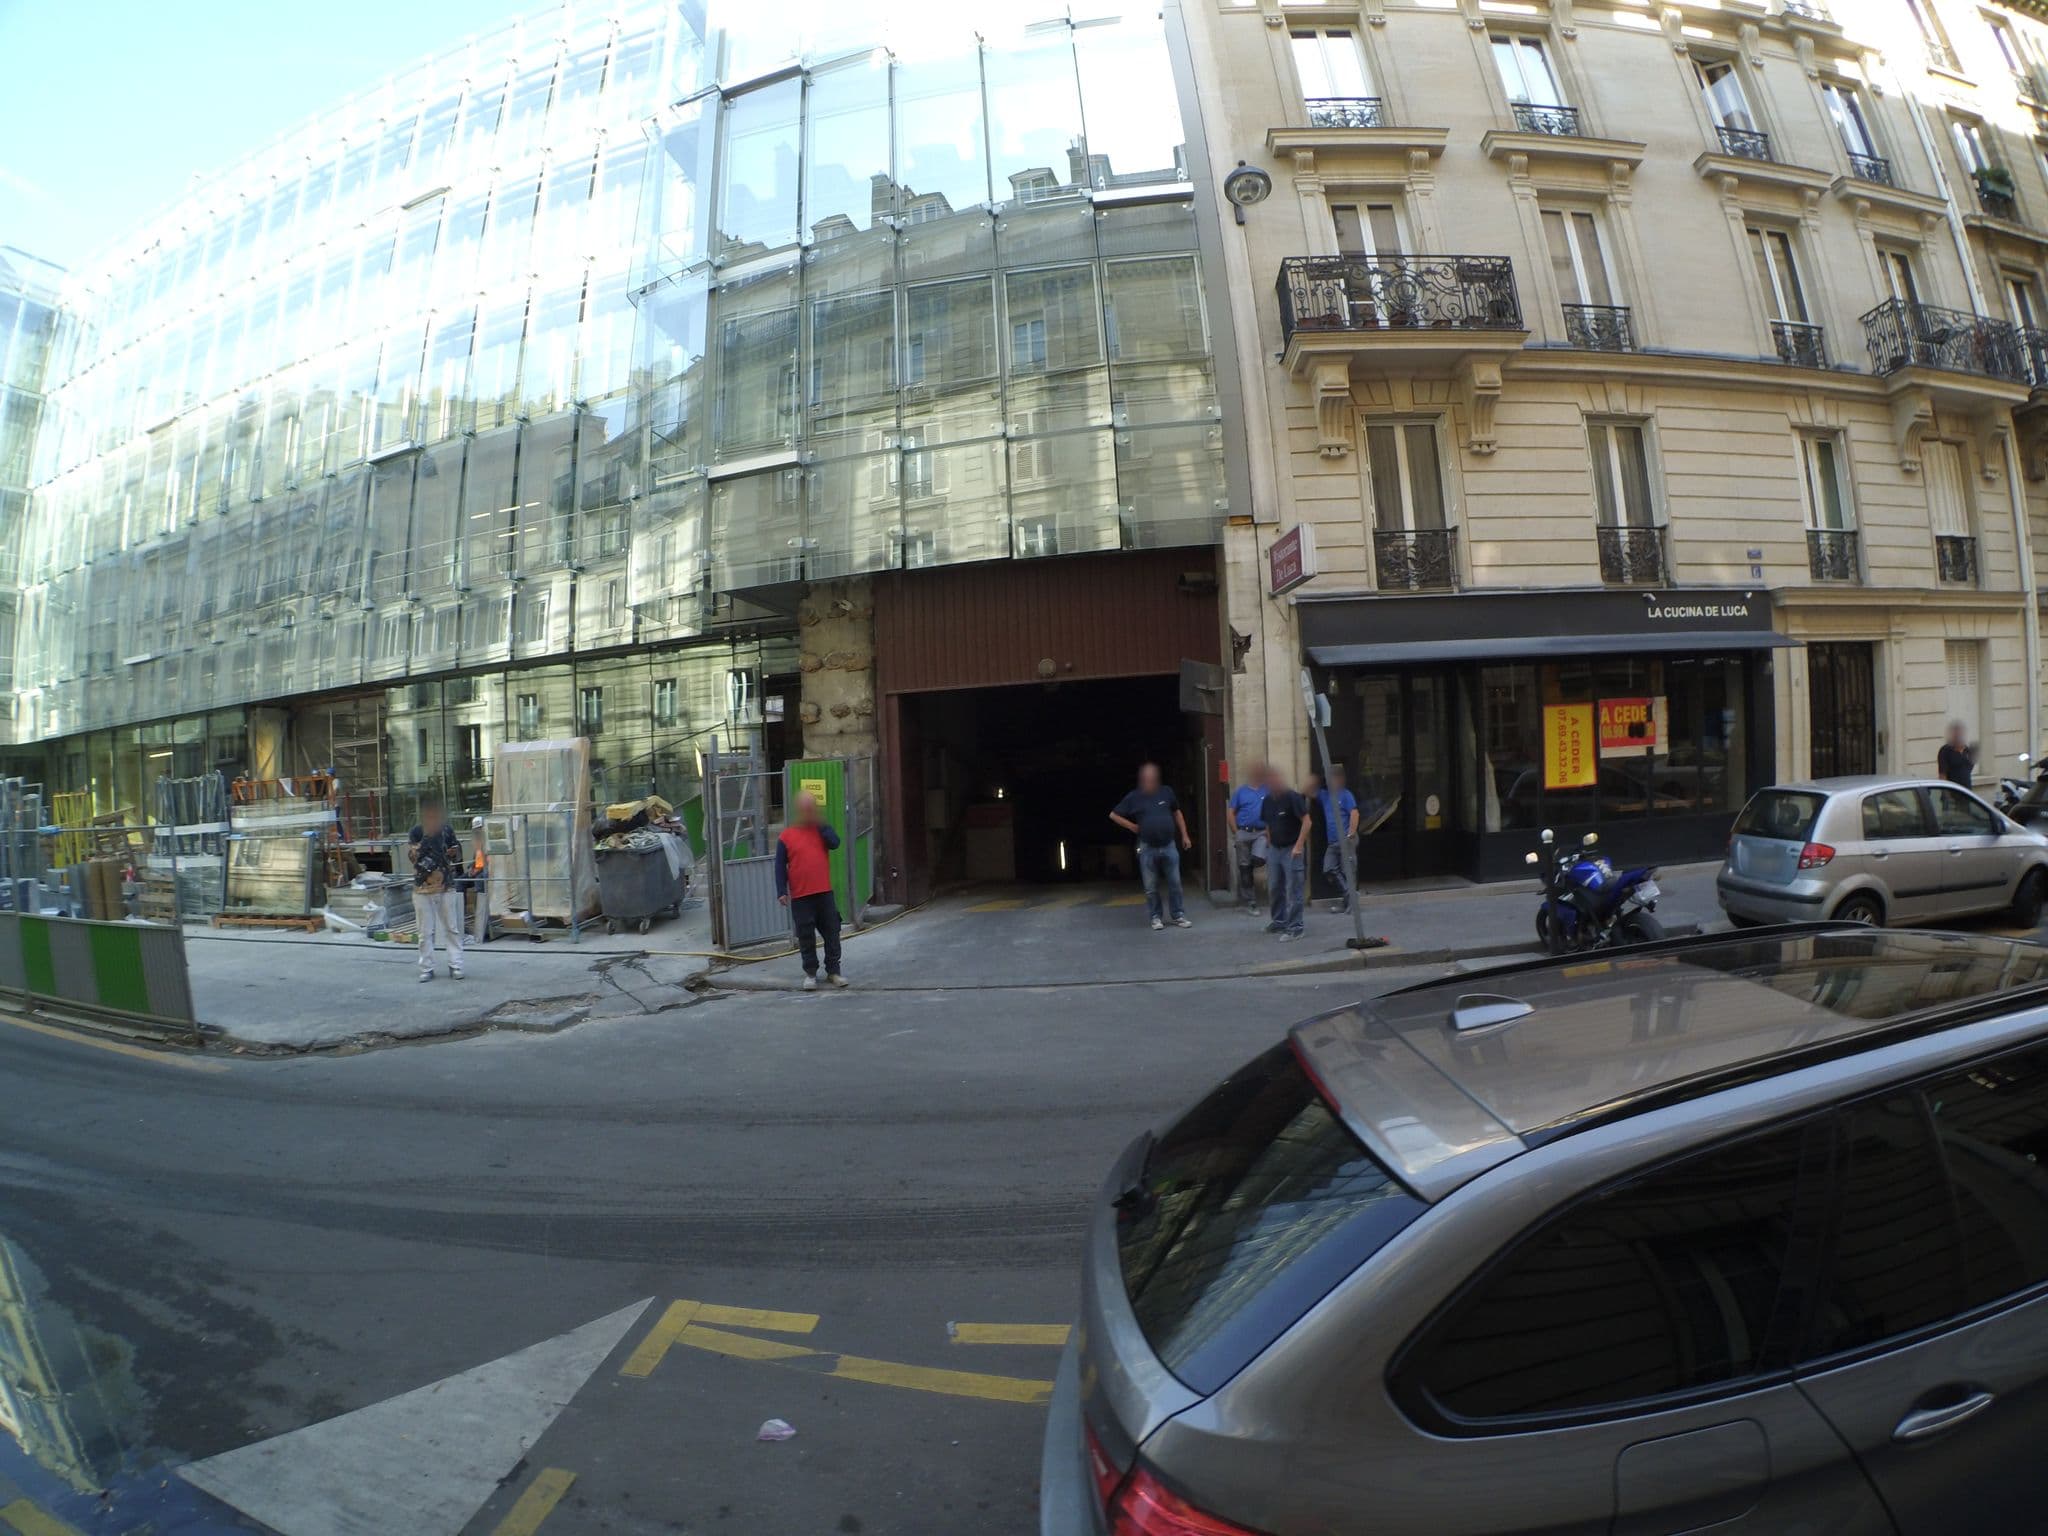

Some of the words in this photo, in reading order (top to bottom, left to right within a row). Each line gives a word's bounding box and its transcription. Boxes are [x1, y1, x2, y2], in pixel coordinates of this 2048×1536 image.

[1647, 607, 1662, 618] LA
[1664, 606, 1703, 618] CUCINA
[1705, 606, 1719, 617] DE
[1721, 605, 1748, 617] LUCA
[1601, 706, 1610, 724] A
[1614, 704, 1652, 723] CEDE
[1571, 716, 1579, 726] A
